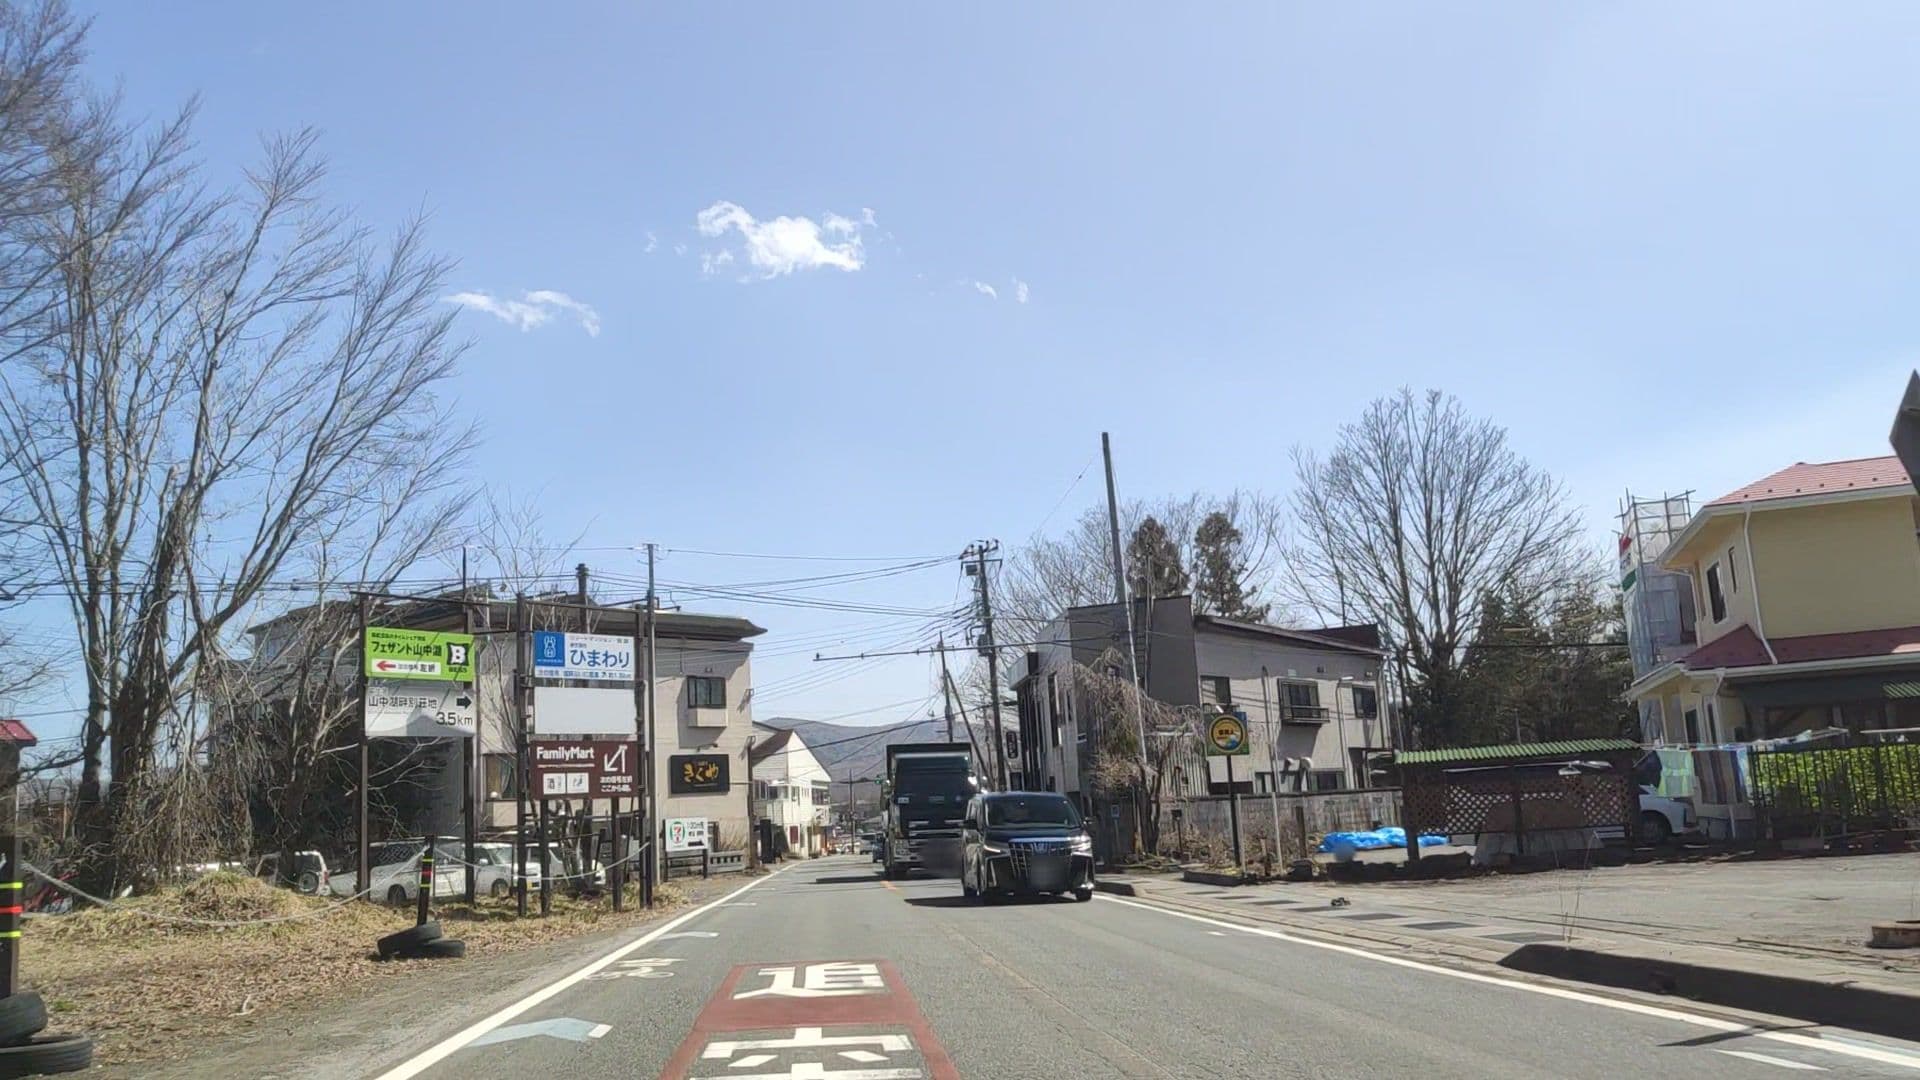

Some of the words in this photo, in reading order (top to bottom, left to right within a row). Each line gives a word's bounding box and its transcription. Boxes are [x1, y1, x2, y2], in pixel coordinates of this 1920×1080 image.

[569, 649, 630, 668] ひまわり
[536, 746, 595, 761] FamilyMart
